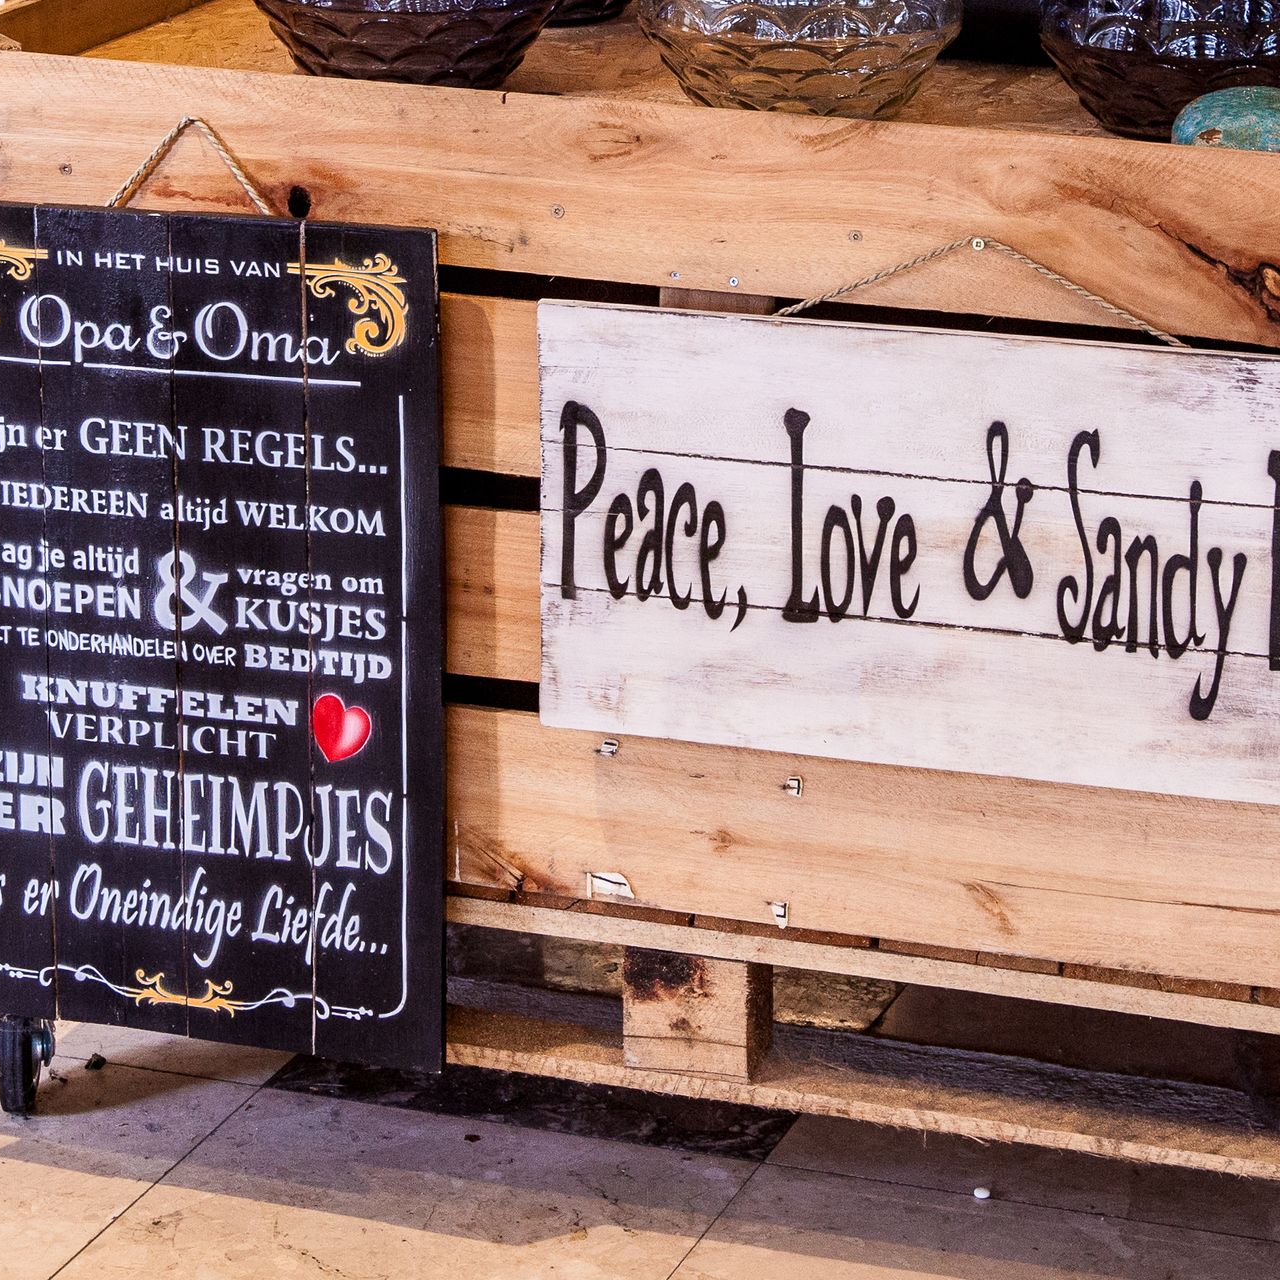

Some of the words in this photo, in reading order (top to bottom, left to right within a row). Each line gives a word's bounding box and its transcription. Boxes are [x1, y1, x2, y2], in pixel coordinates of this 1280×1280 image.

[56, 249, 83, 267] IN
[94, 251, 146, 272] HET
[154, 256, 221, 275] HUIS
[230, 261, 281, 279] VAN
[20, 294, 142, 363] Opa
[146, 305, 188, 360] &
[193, 301, 341, 367] Oma
[35, 426, 68, 452] er
[78, 417, 188, 460] GEEN
[201, 426, 388, 477] REGELS...
[0, 480, 149, 519] IEDEREEN
[159, 494, 229, 532] altijd
[235, 499, 387, 537] WELKOM
[37, 539, 66, 571] je
[72, 544, 141, 578] altijd
[236, 567, 333, 598] vragen
[341, 574, 386, 596] om
[558, 399, 748, 633] Peace,
[782, 406, 923, 624] Love
[962, 419, 1035, 602] &
[1056, 427, 1250, 721] Sandy
[153, 549, 229, 635] &
[234, 595, 387, 642] KUSJES
[18, 624, 41, 646] TE
[45, 626, 188, 662] ONDERHANDELEN
[192, 643, 237, 667] OVER
[244, 642, 394, 685] BEDTIJD
[21, 674, 300, 727] KNUFFELEN
[45, 709, 278, 760] VERPLICHT
[78, 760, 394, 875] GEHEIMPJES
[23, 880, 59, 917] er
[68, 862, 243, 969] Oneindige
[250, 881, 389, 967] Liefde...
